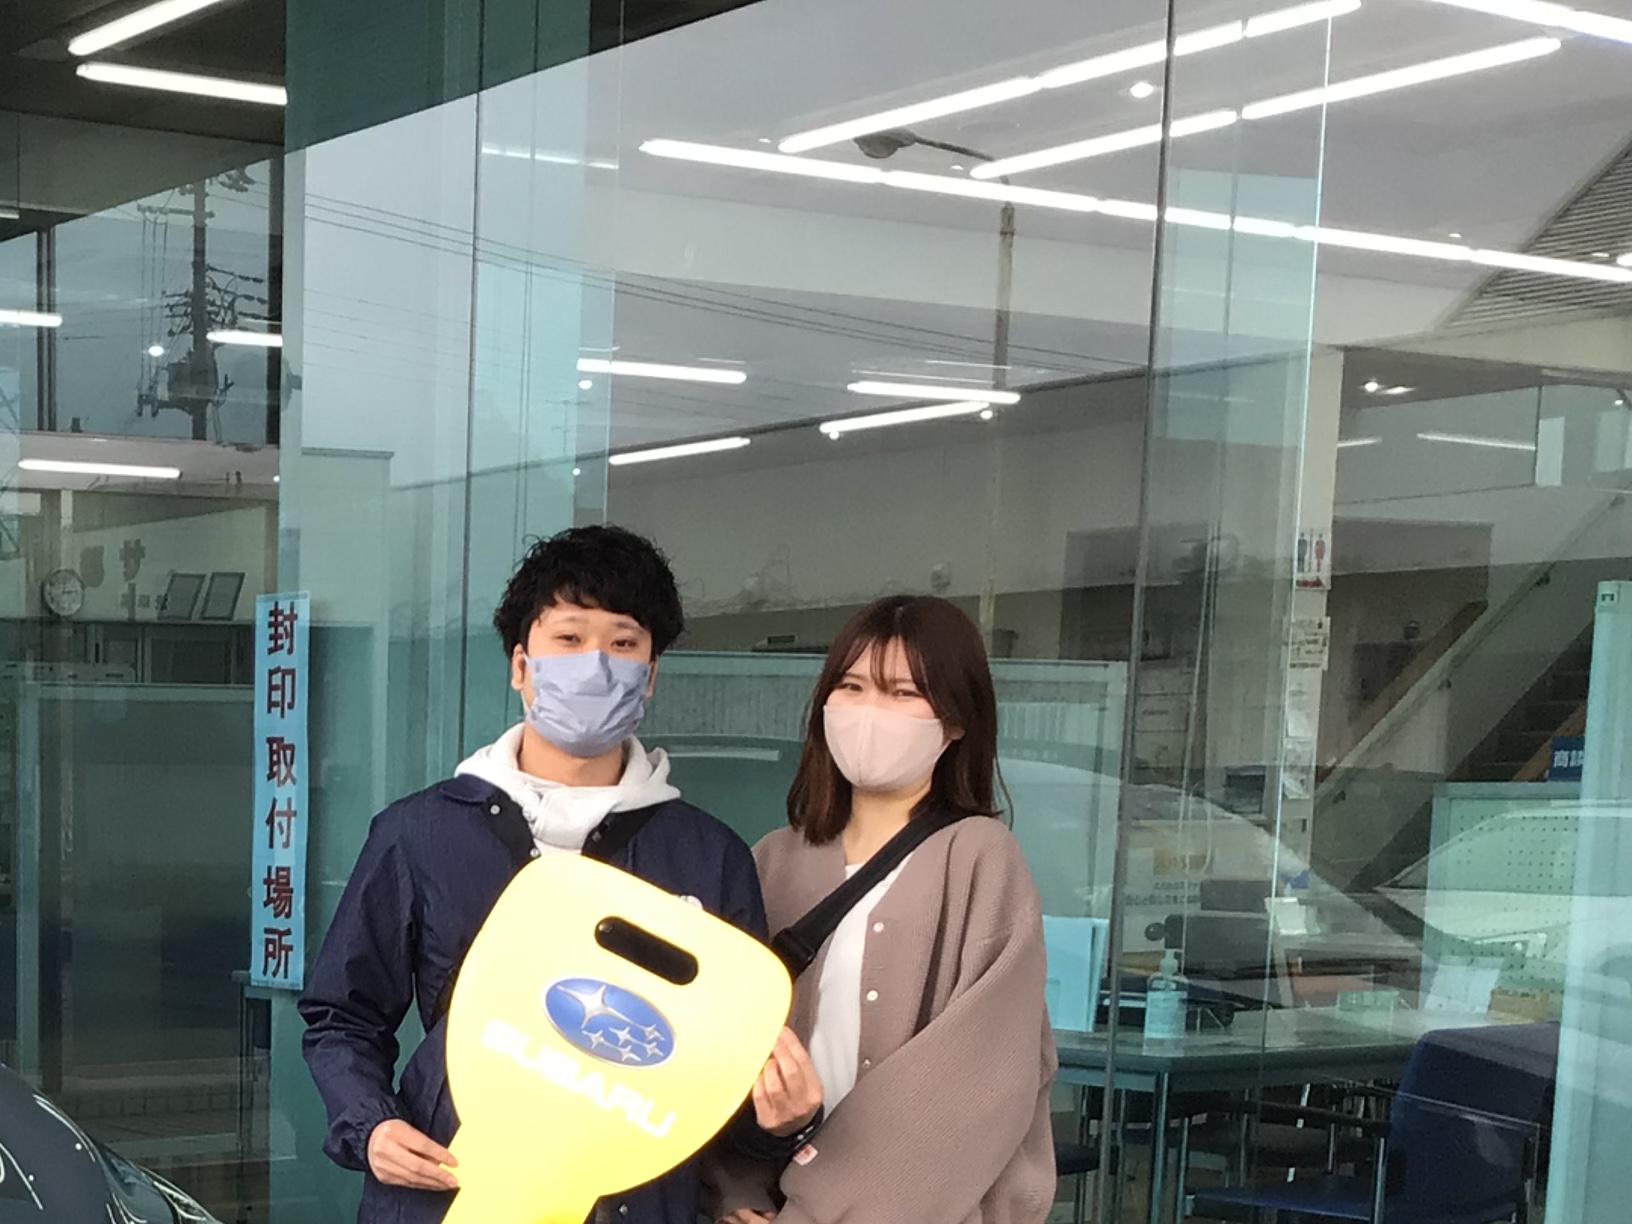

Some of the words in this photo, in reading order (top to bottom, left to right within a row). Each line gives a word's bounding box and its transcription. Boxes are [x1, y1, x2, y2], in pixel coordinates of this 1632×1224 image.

[262, 599, 299, 980] 封印取付場所
[480, 1019, 677, 1138] SUBARU
